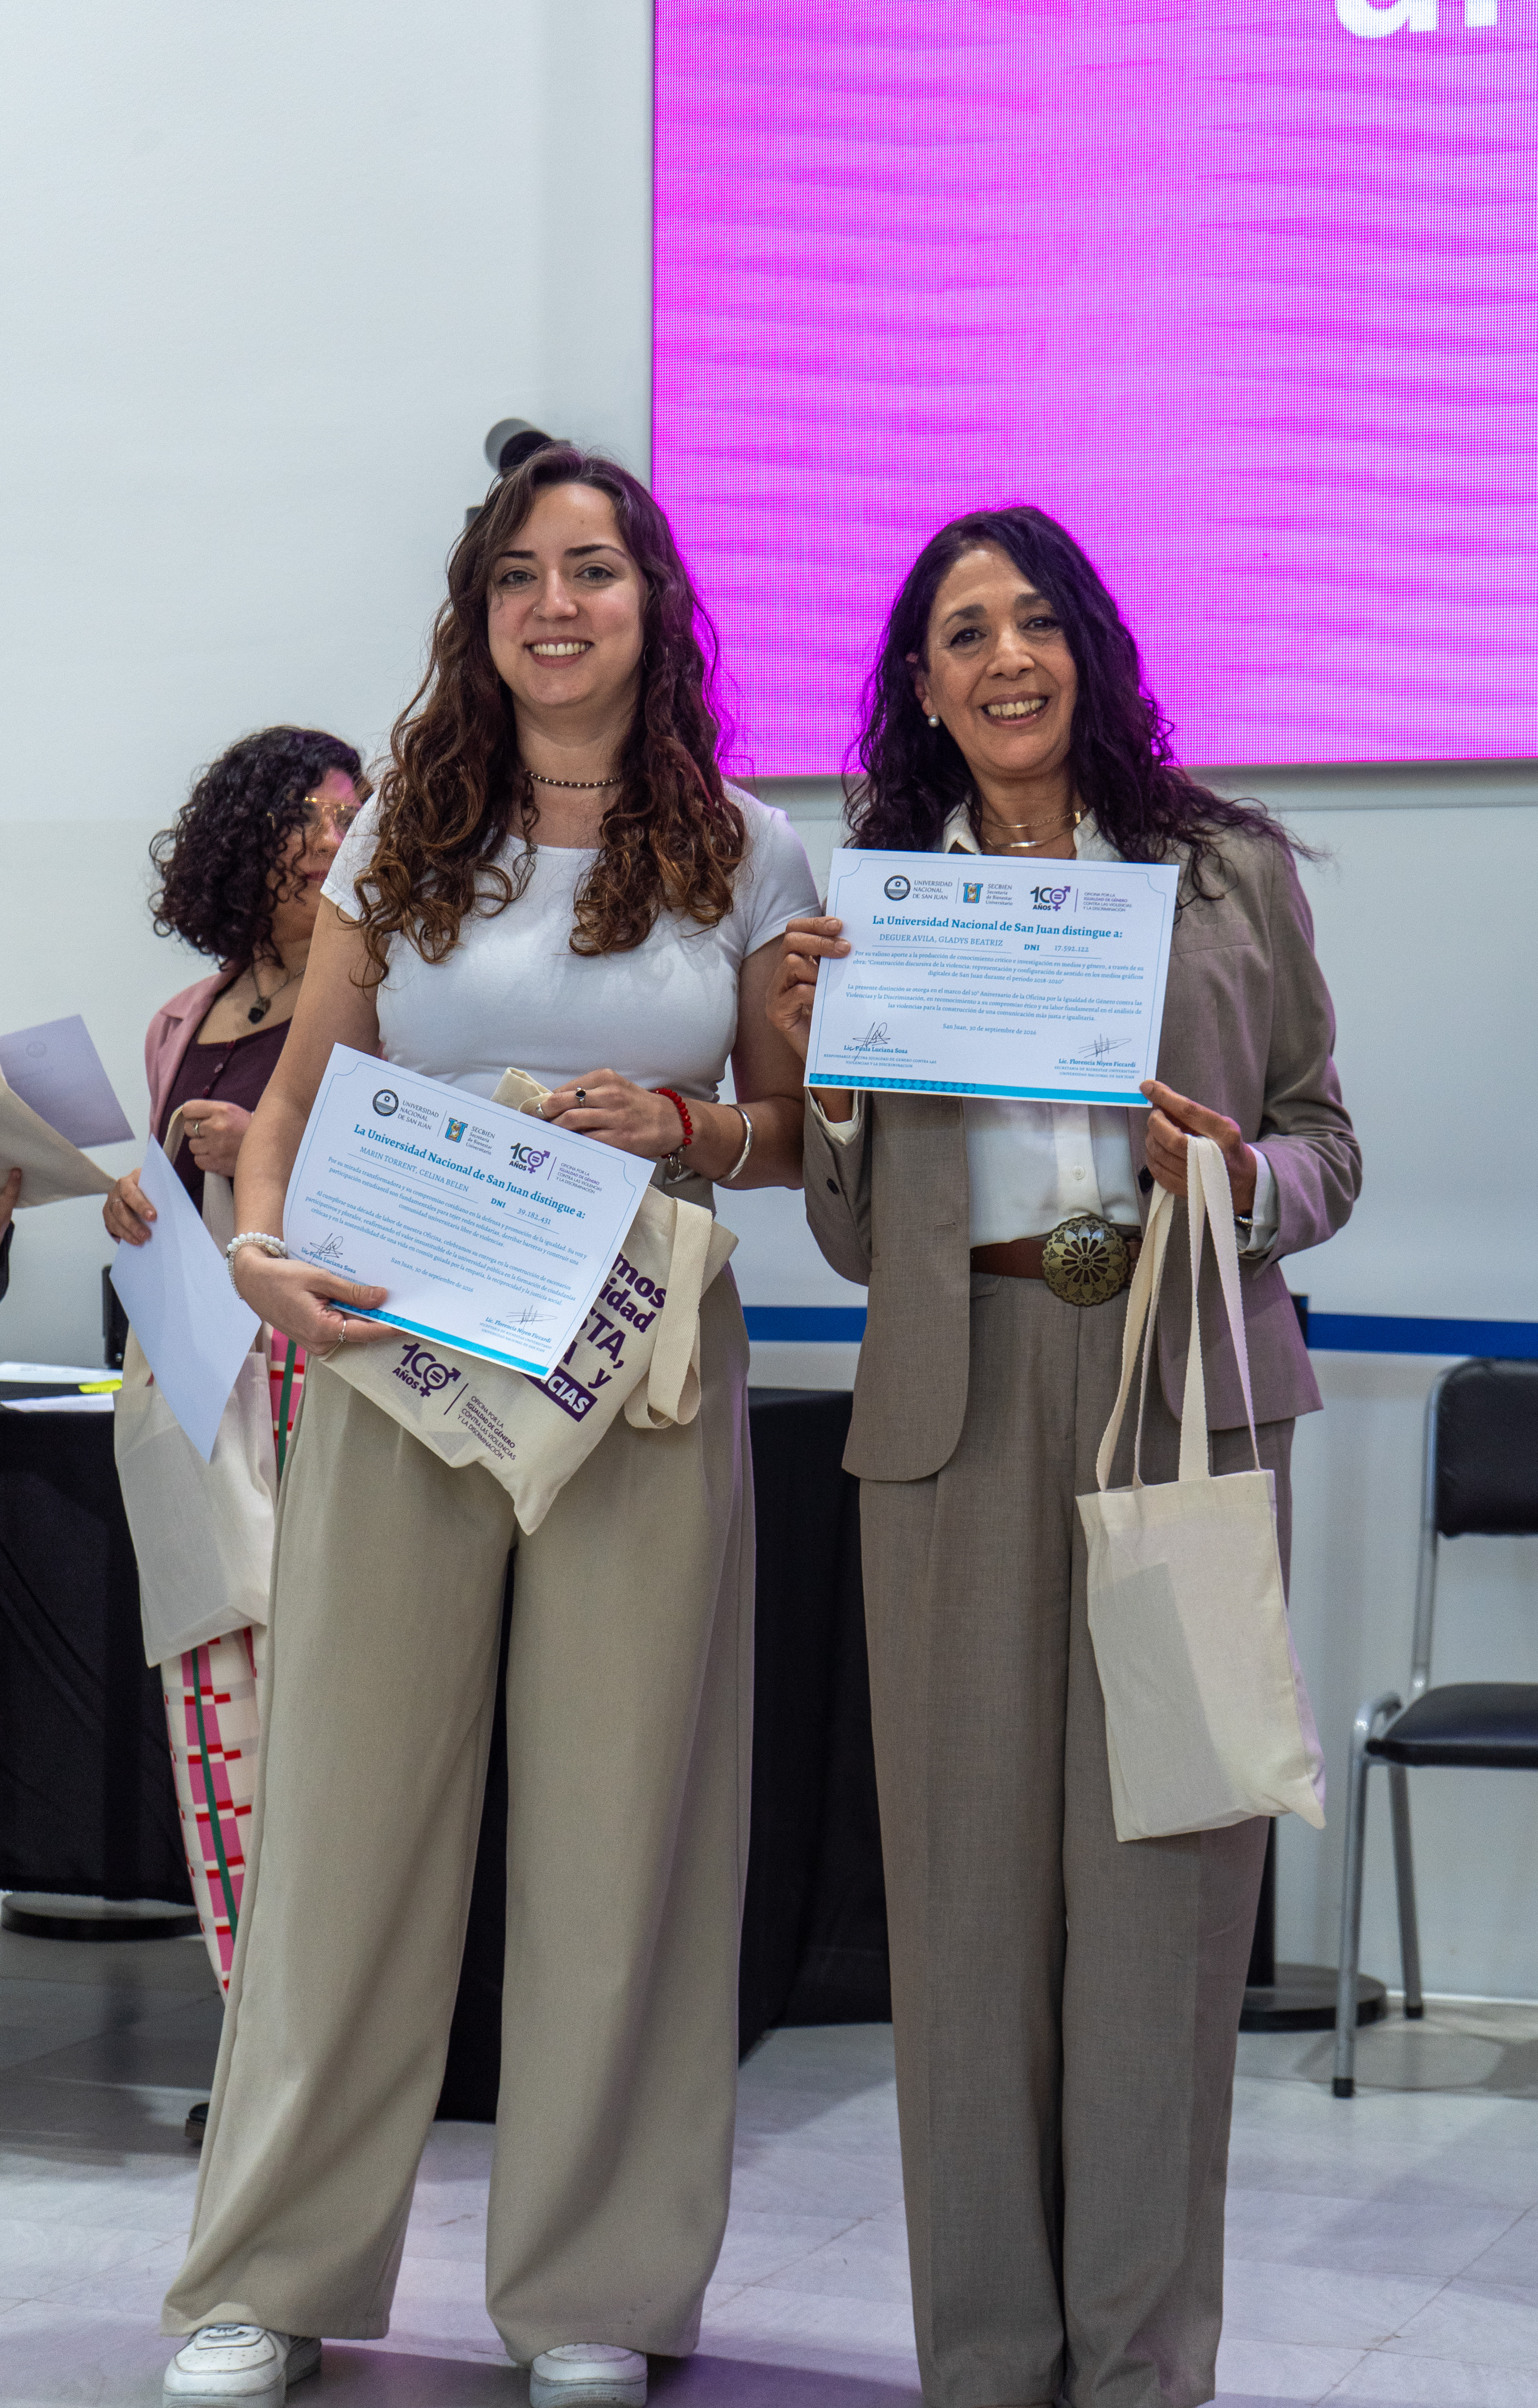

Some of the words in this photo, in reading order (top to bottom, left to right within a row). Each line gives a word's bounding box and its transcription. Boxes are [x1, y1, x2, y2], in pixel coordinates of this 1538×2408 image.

[1033, 901, 1051, 911] AÑOS
[872, 915, 885, 925] La
[887, 916, 949, 927] Universidad
[951, 919, 998, 930] Nacional
[999, 921, 1012, 932] de
[1014, 923, 1034, 933] San
[1035, 924, 1060, 935] Juan
[1062, 925, 1111, 940] distingue
[879, 934, 911, 942] DEGUER
[912, 935, 937, 943] AVILA,
[938, 936, 969, 944] GLADYS
[970, 938, 1003, 946] BEATRIZ
[400, 1107, 428, 1122] NACIONAL
[402, 1100, 439, 1118] UNIVERSIDAD
[406, 1117, 417, 1125] SAN
[417, 1121, 432, 1130] JUAN
[471, 1126, 495, 1139] SECBIEN
[466, 1142, 492, 1155] Universitario
[473, 1139, 492, 1150] Bienestar
[353, 1124, 366, 1136] La
[368, 1129, 428, 1159] Universidad
[427, 1152, 473, 1176] Nacional
[472, 1169, 485, 1181] de
[486, 1174, 505, 1189] San
[505, 1181, 529, 1198] Juan
[530, 1191, 576, 1215] distingue
[576, 1211, 586, 1219] a:
[359, 1146, 384, 1160] MARIN
[384, 1155, 417, 1174] TORRENT,
[419, 1169, 444, 1184] CELINA
[445, 1179, 469, 1193] BELEN
[509, 1160, 527, 1171] AÑOS
[561, 1163, 576, 1171] OFICINA
[557, 1172, 573, 1180] CONTRA
[581, 1180, 602, 1192] VIOLENCIAS
[559, 1167, 579, 1177] IGUALDAD
[584, 1177, 600, 1185] GÉNERO
[564, 1179, 595, 1194] DISCRIMINACIÓN
[328, 1156, 337, 1164] Por
[343, 1164, 361, 1174] mirada
[362, 1170, 402, 1189] transformadora
[412, 1190, 445, 1205] compromiso
[444, 1202, 469, 1214] cotidiano
[481, 1215, 501, 1227] defensa
[504, 1225, 532, 1238] promoción
[544, 1239, 567, 1251] igualdad.
[491, 1198, 506, 1208] DNI
[398, 1204, 428, 1218] comunidad
[428, 1215, 460, 1230] universitaria
[460, 1226, 472, 1234] libre
[479, 1234, 504, 1247] violencias.
[517, 1208, 551, 1225] 39.182.431
[309, 1251, 322, 1261] Paula
[323, 1257, 343, 1269] Luciana
[343, 1265, 356, 1274] Sosa
[390, 1257, 401, 1265] San
[400, 1261, 414, 1271] Juan,
[428, 1273, 456, 1286] septiembre
[494, 1320, 517, 1331] Florencia
[517, 1328, 532, 1337] Niyen
[531, 1333, 552, 1343] Ficcardi
[392, 1367, 419, 1389] AÑOS
[588, 1368, 612, 1388] y
[541, 1373, 589, 1413] CIAS
[471, 1396, 489, 1414] OFICINA
[488, 1412, 497, 1423] POR
[497, 1420, 503, 1428] LA
[462, 1409, 481, 1427] CONTRA
[480, 1425, 488, 1435] LAS
[488, 1433, 516, 1460] VIOLENCIAS
[466, 1402, 488, 1424] IGUALDAD
[487, 1422, 495, 1430] DE
[494, 1429, 515, 1448] GÉNERO
[461, 1418, 468, 1426] LA
[468, 1424, 504, 1460] DISCRIMINACIÓN
